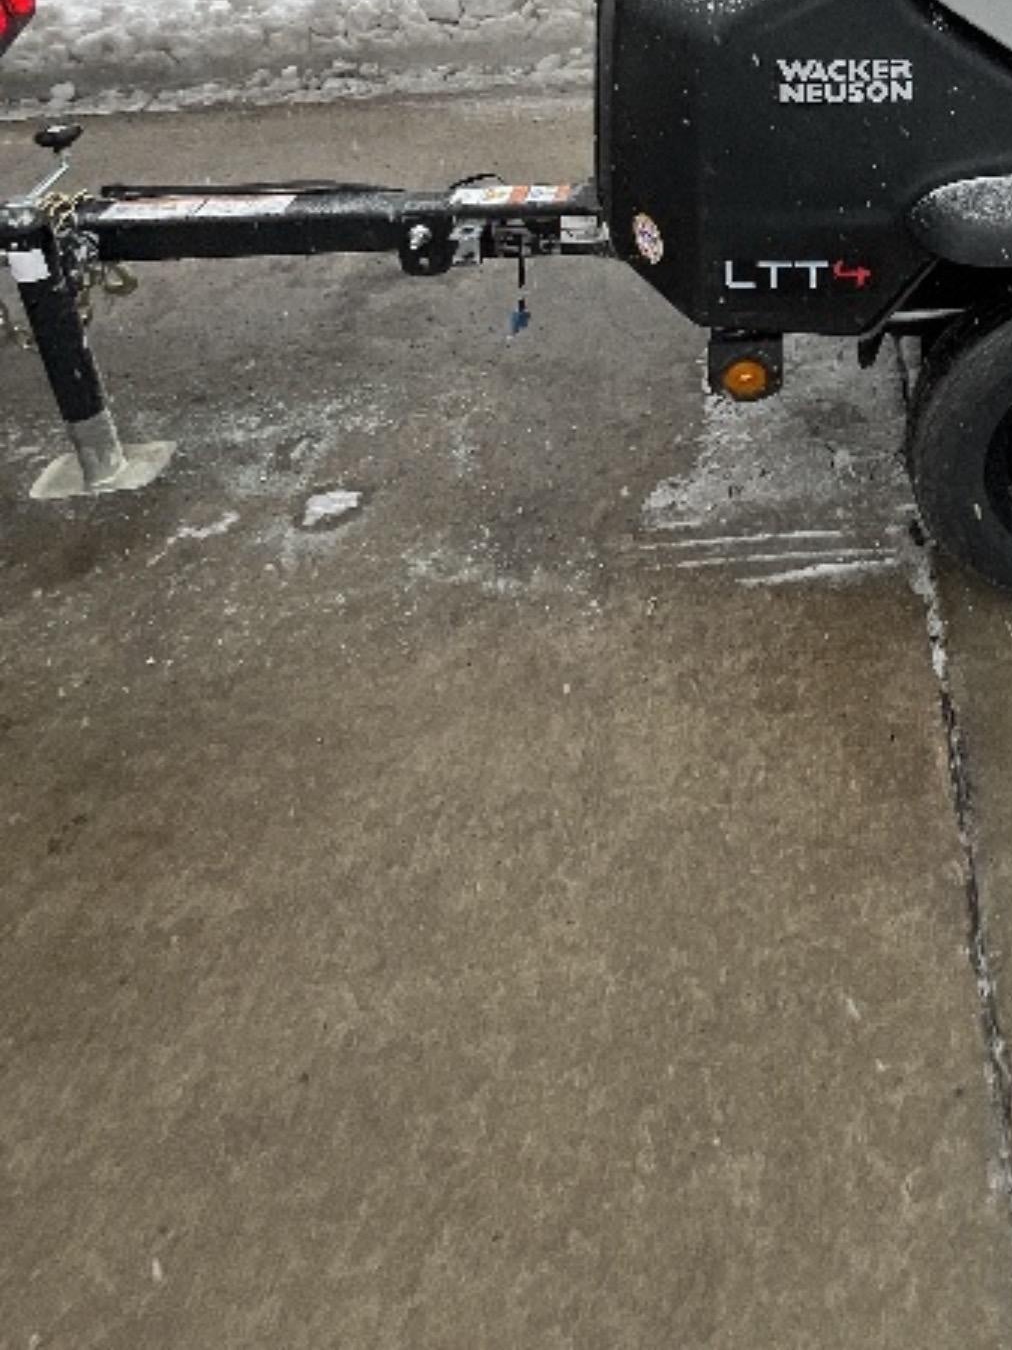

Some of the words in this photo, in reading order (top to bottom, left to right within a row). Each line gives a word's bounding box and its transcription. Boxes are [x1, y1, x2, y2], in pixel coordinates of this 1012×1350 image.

[776, 59, 913, 83] WACKER
[778, 80, 914, 103] NEUSON
[725, 259, 872, 290] LTT4
